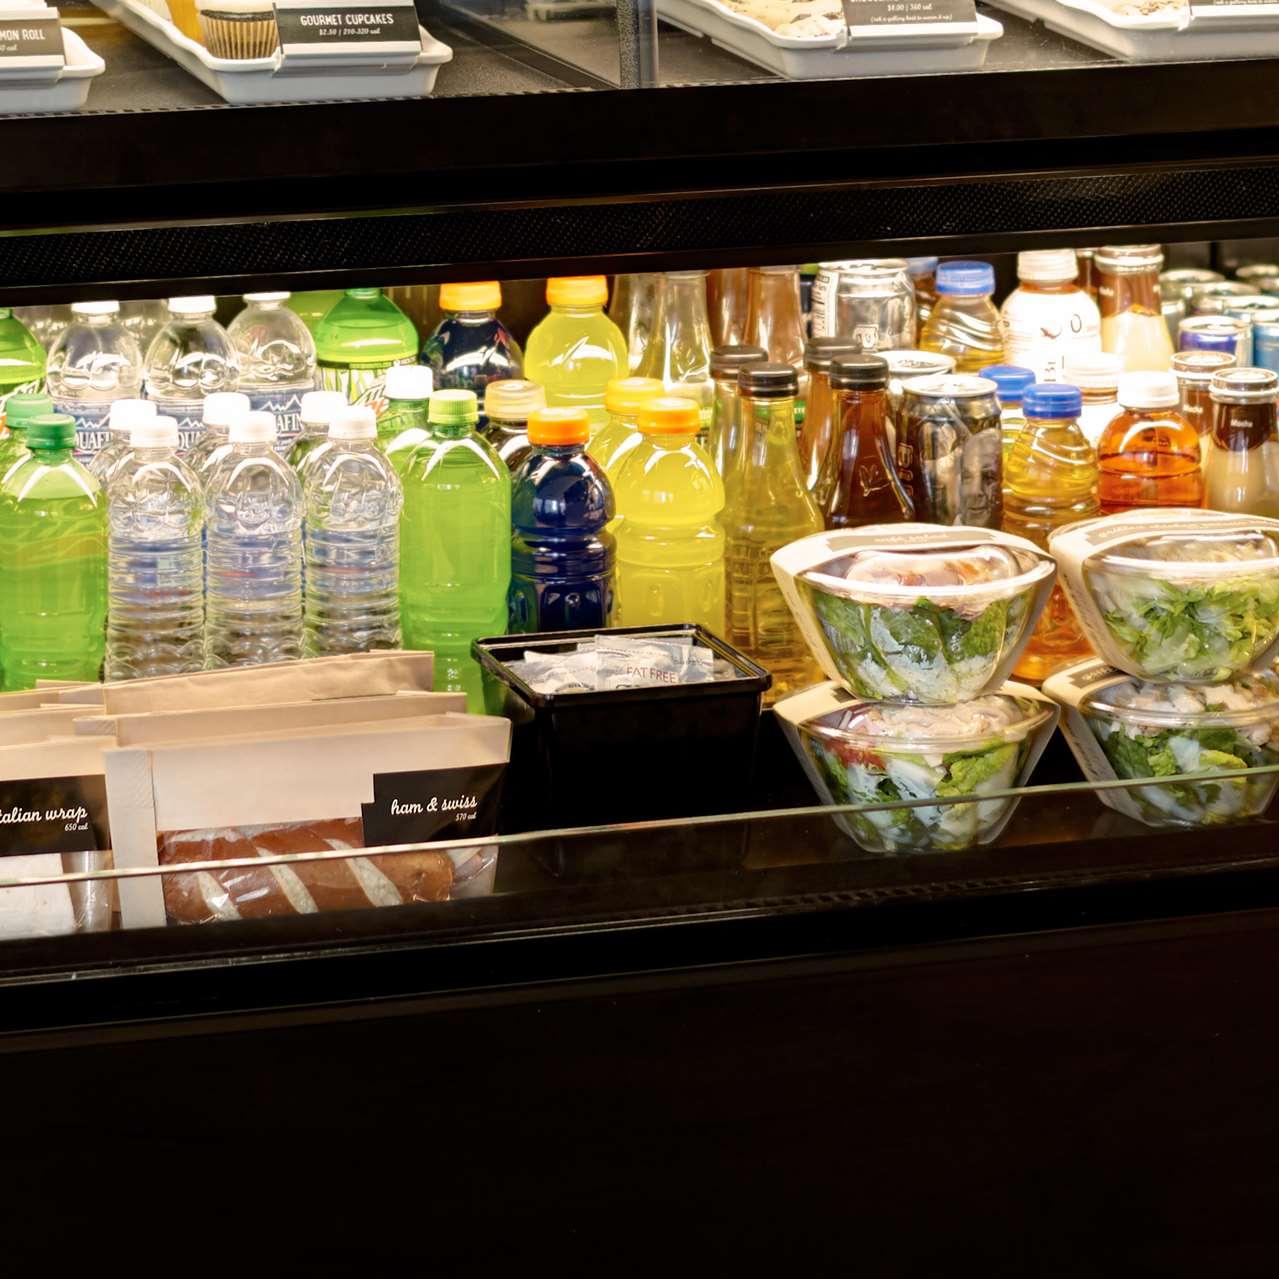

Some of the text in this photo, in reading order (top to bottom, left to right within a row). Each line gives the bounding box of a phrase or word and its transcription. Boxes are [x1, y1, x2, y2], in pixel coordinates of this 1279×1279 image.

[301, 13, 394, 26] GOURMET CUPCAKES
[22, 29, 46, 40] ROLL
[626, 666, 677, 683] FAT FREE
[391, 795, 478, 815] ham & swiss
[45, 806, 88, 823] wrap
[64, 823, 77, 831] 650
